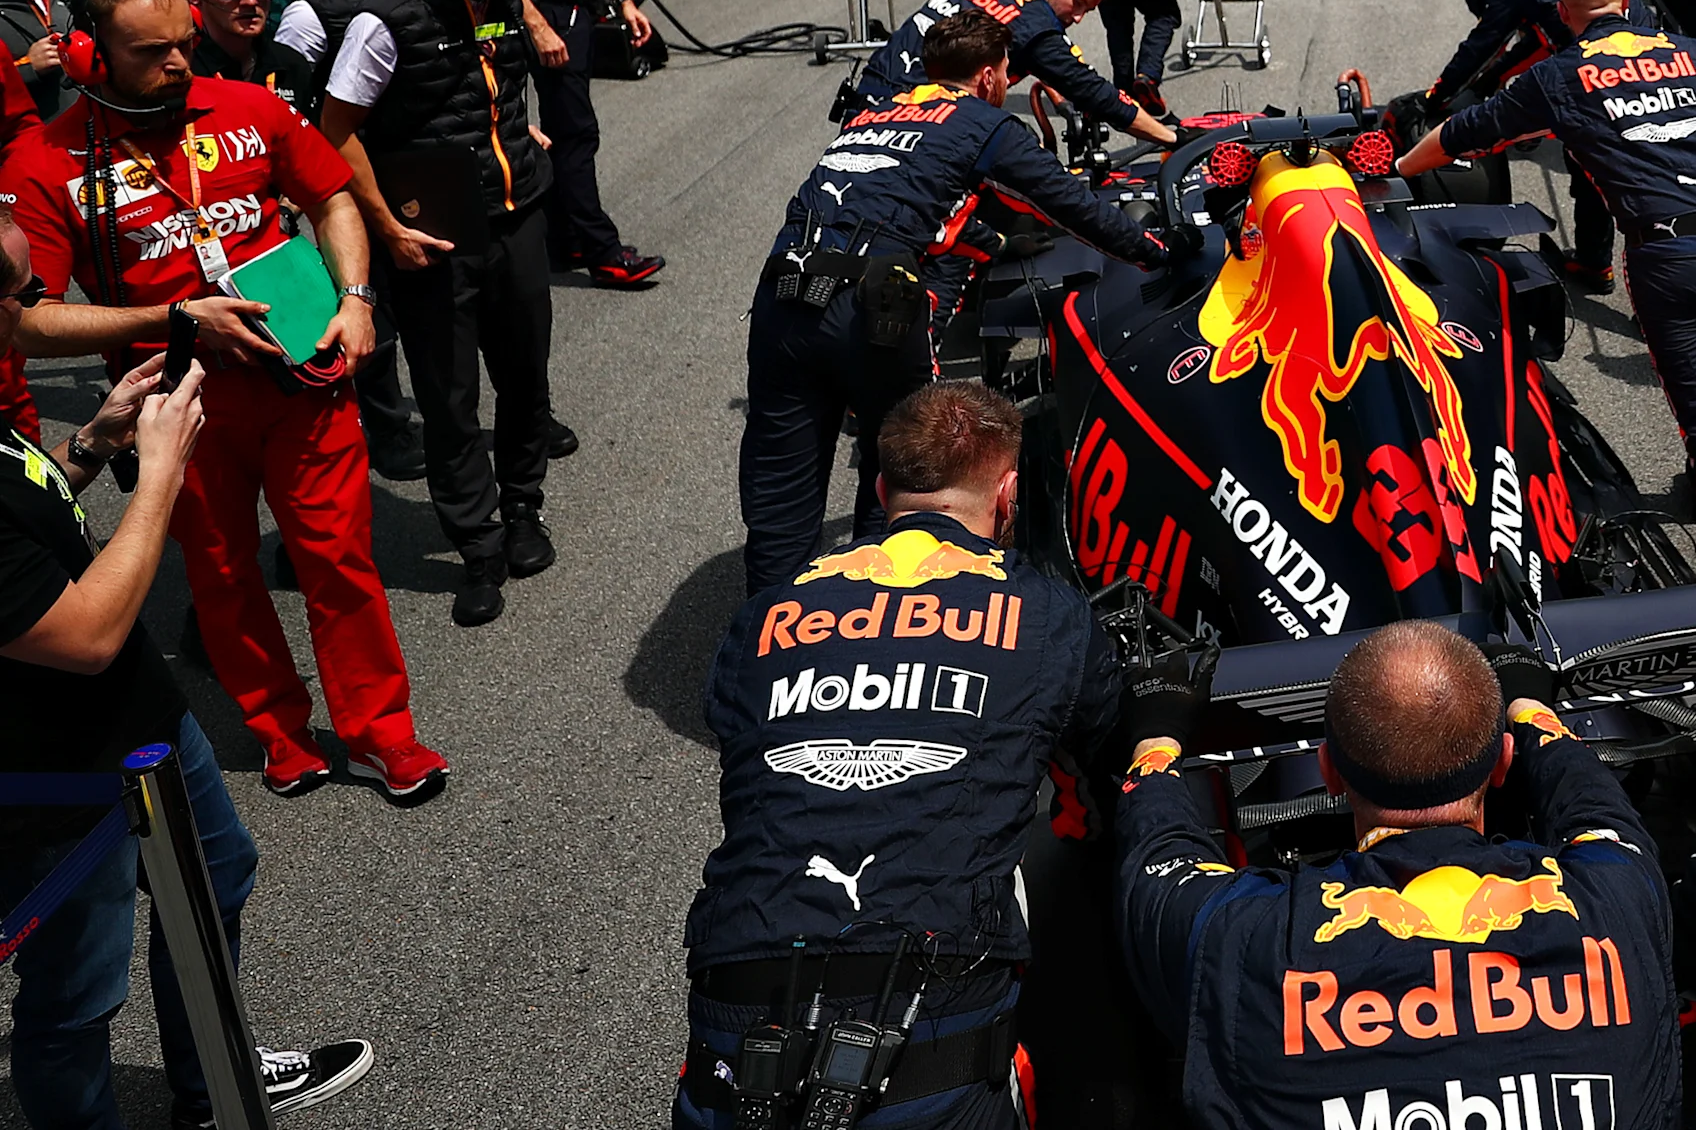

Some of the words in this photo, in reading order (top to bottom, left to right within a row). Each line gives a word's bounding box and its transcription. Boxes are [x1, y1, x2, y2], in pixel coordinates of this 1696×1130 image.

[1577, 58, 1640, 94] Red
[899, 101, 957, 127] Bull
[1602, 87, 1676, 121] Mobil
[1489, 446, 1524, 568] ONDA
[1210, 467, 1351, 635] HONDA
[757, 592, 890, 658] Red
[892, 592, 1022, 651] Bull
[1257, 587, 1311, 641] HYBR
[767, 663, 925, 721] Mobil
[1571, 654, 1680, 684] MARTIN
[817, 749, 856, 762] ASTON
[857, 749, 902, 762] MARTIN
[1281, 948, 1459, 1056] Red
[1467, 935, 1632, 1034] Bull
[1321, 1073, 1543, 1130] Mobil
